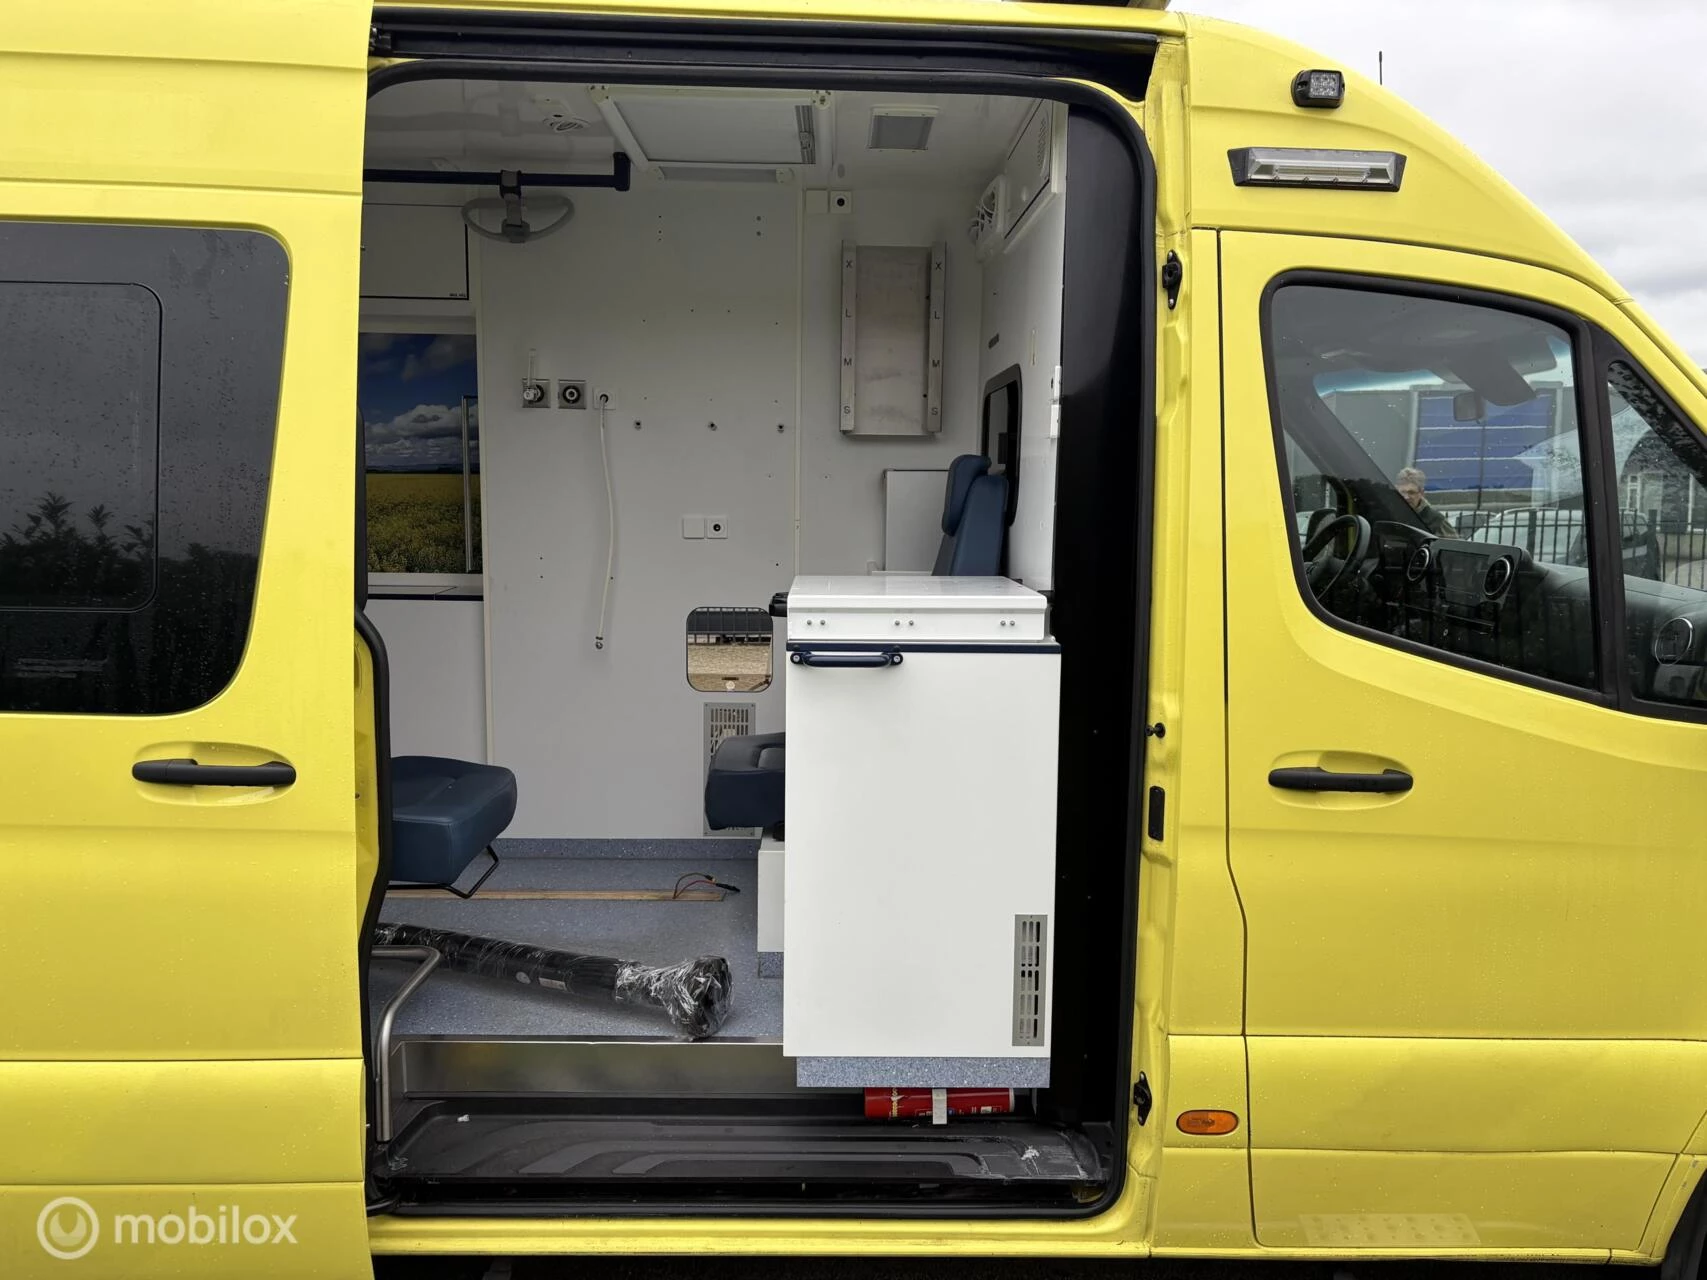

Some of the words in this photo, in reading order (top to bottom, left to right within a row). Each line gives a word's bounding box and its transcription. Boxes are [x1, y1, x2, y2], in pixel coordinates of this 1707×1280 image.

[845, 260, 852, 269] X
[935, 262, 942, 271] X
[845, 309, 852, 318] L
[934, 311, 940, 320] L
[843, 358, 852, 366] M
[932, 359, 940, 368] M
[843, 406, 851, 415] S
[931, 407, 938, 416] S
